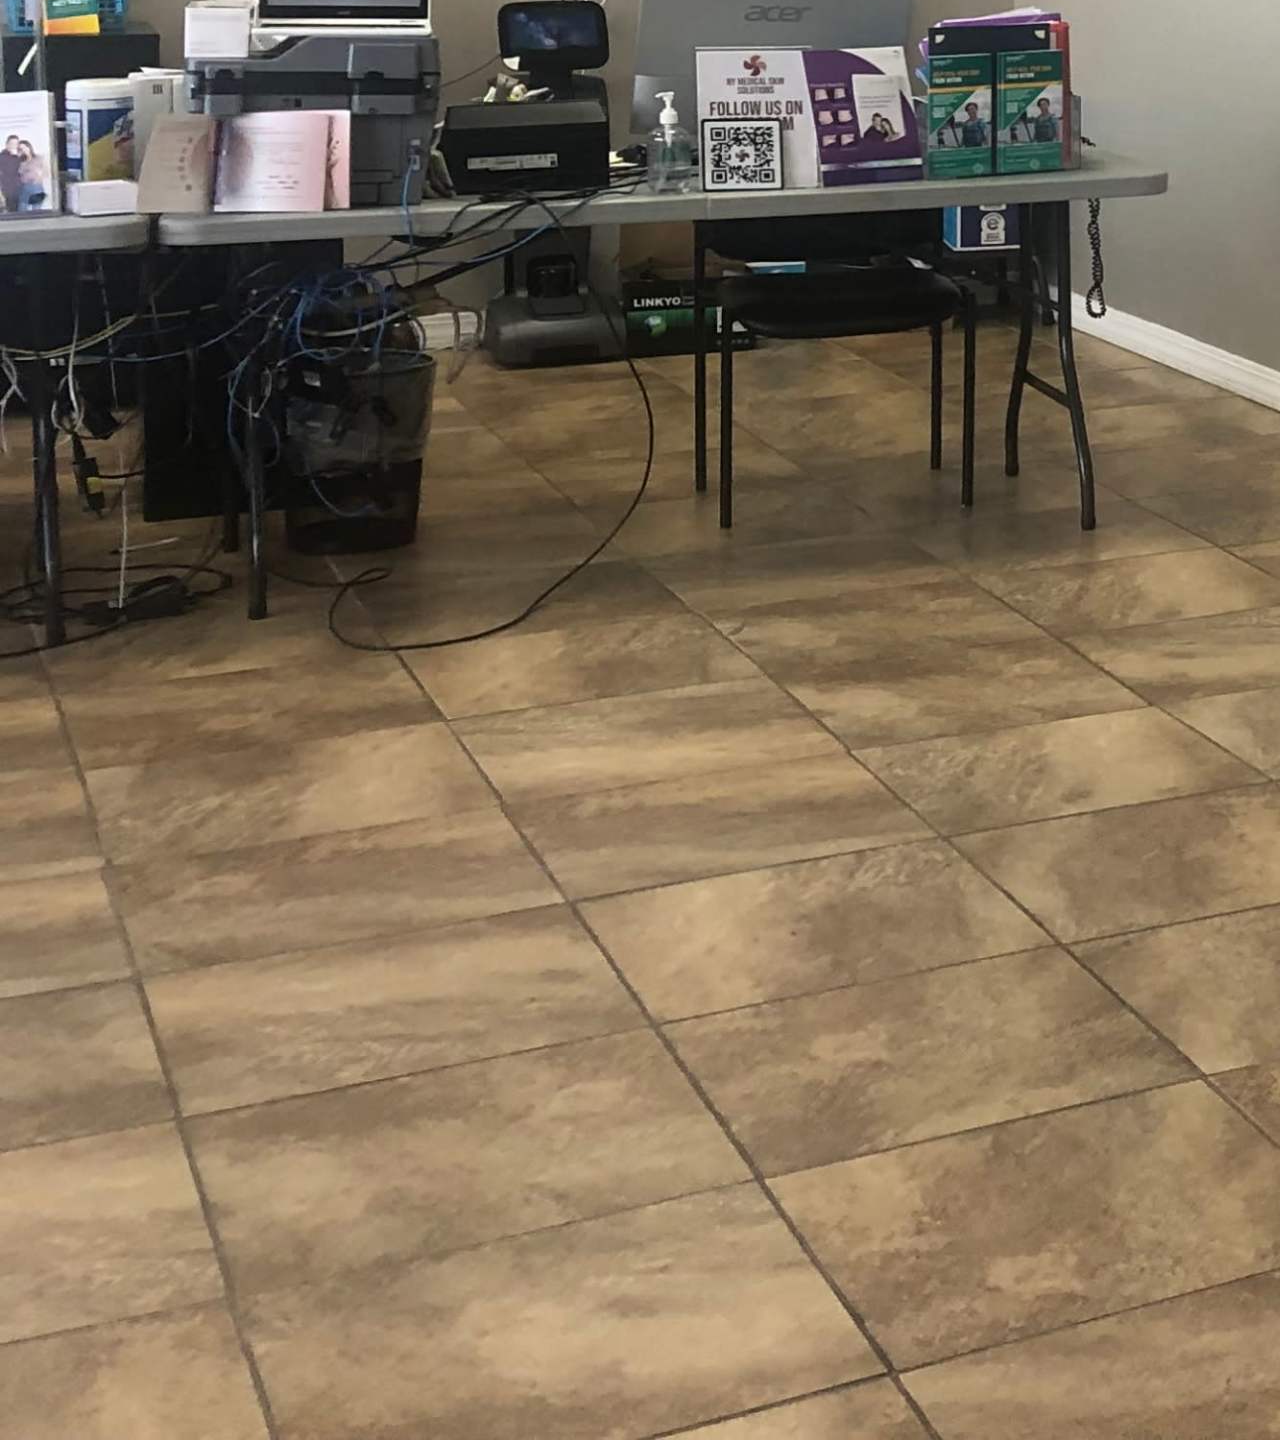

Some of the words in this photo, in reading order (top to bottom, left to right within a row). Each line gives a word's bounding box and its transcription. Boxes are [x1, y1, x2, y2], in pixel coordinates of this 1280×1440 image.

[744, 5, 813, 22] acer
[737, 86, 774, 94] SOLUTIONS
[709, 101, 761, 116] FOLLOW
[765, 100, 782, 115] US
[785, 100, 803, 115] ON
[633, 296, 681, 308] LINKYO
